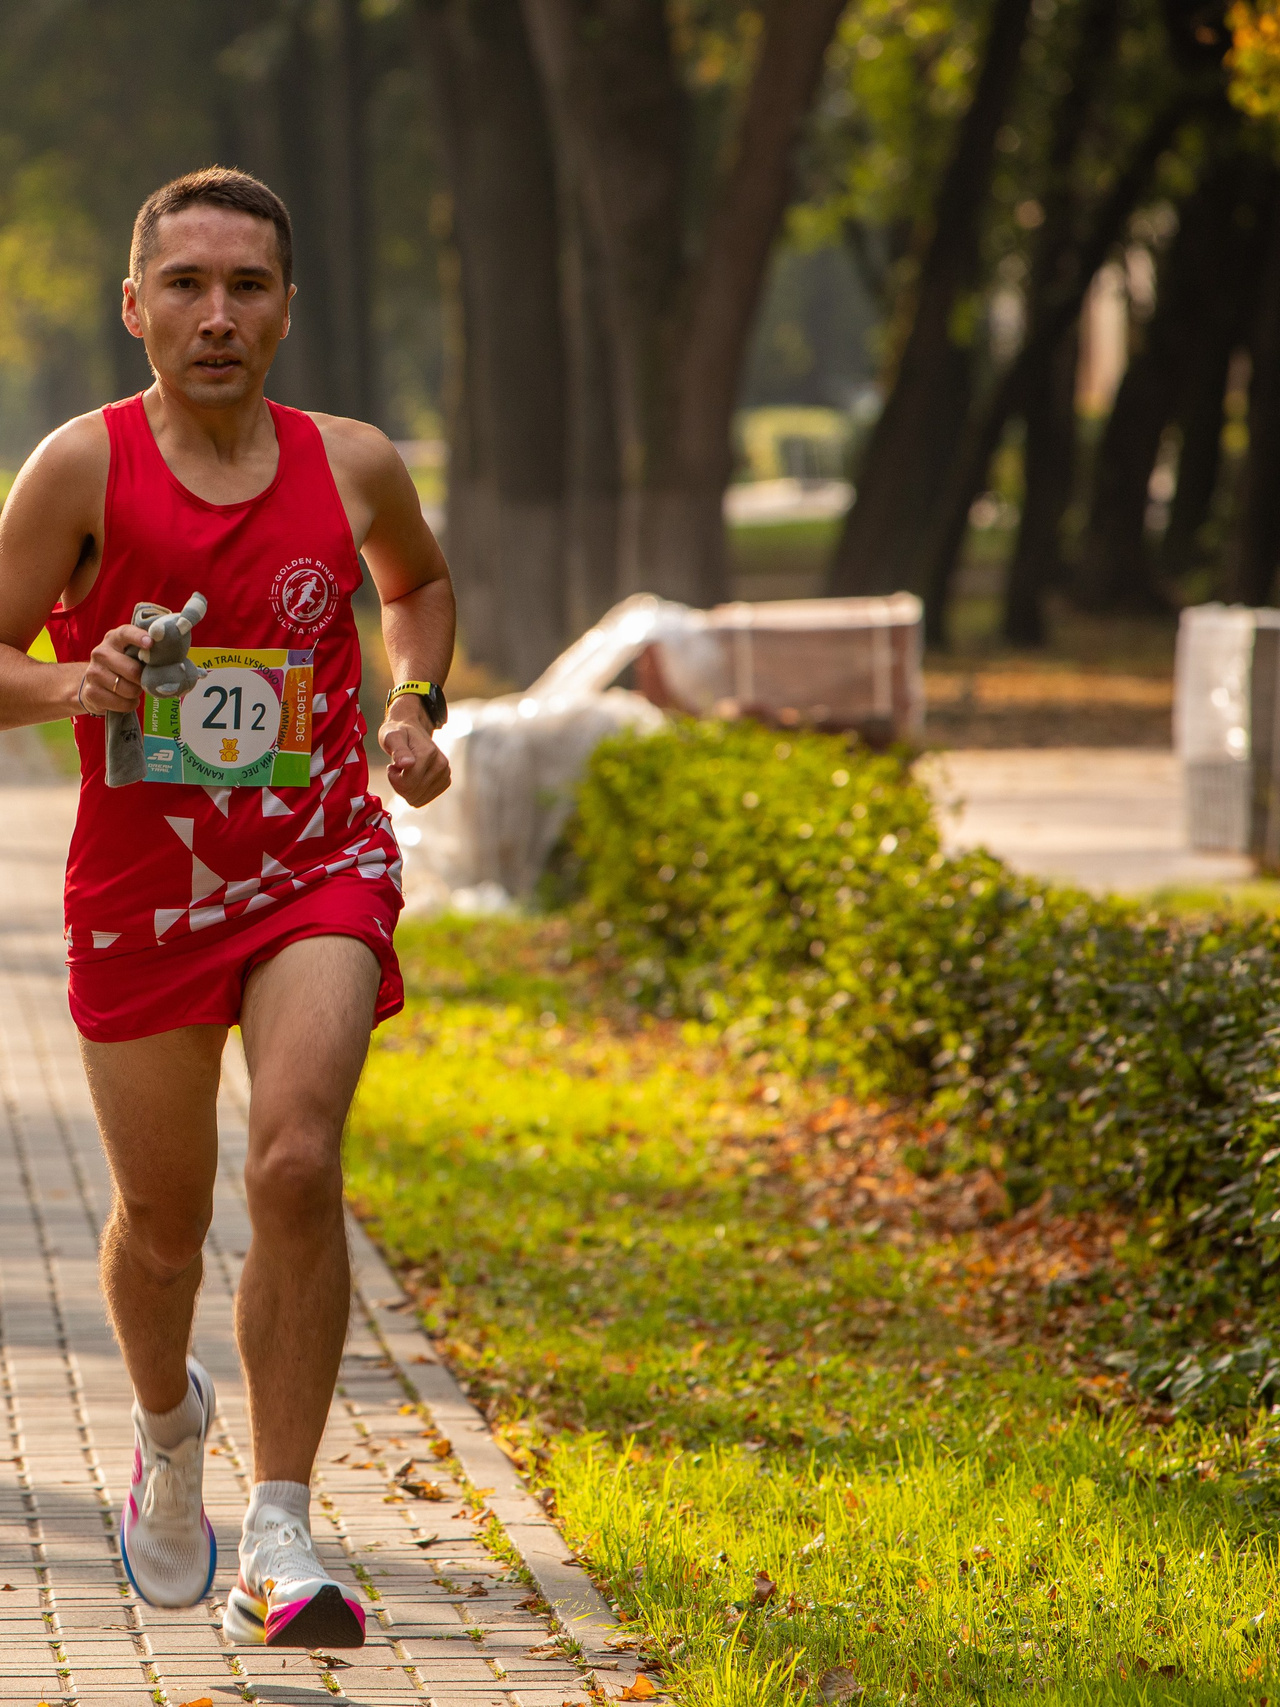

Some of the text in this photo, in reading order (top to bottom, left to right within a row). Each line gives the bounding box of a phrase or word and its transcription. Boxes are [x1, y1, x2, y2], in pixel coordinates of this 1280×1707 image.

[275, 557, 335, 582] GOLDEN RING
[277, 614, 333, 635] ULTRA TRAIL
[214, 654, 242, 665] TRAIL
[243, 656, 280, 685] LYSKOVO
[170, 699, 181, 726] TRAIL
[202, 685, 266, 731] 21 2
[295, 680, 307, 742] ЭСТАФЕТА
[241, 700, 290, 779] ХИМКИНСКИЙ ЛЕС
[186, 755, 225, 780] KANNAS
